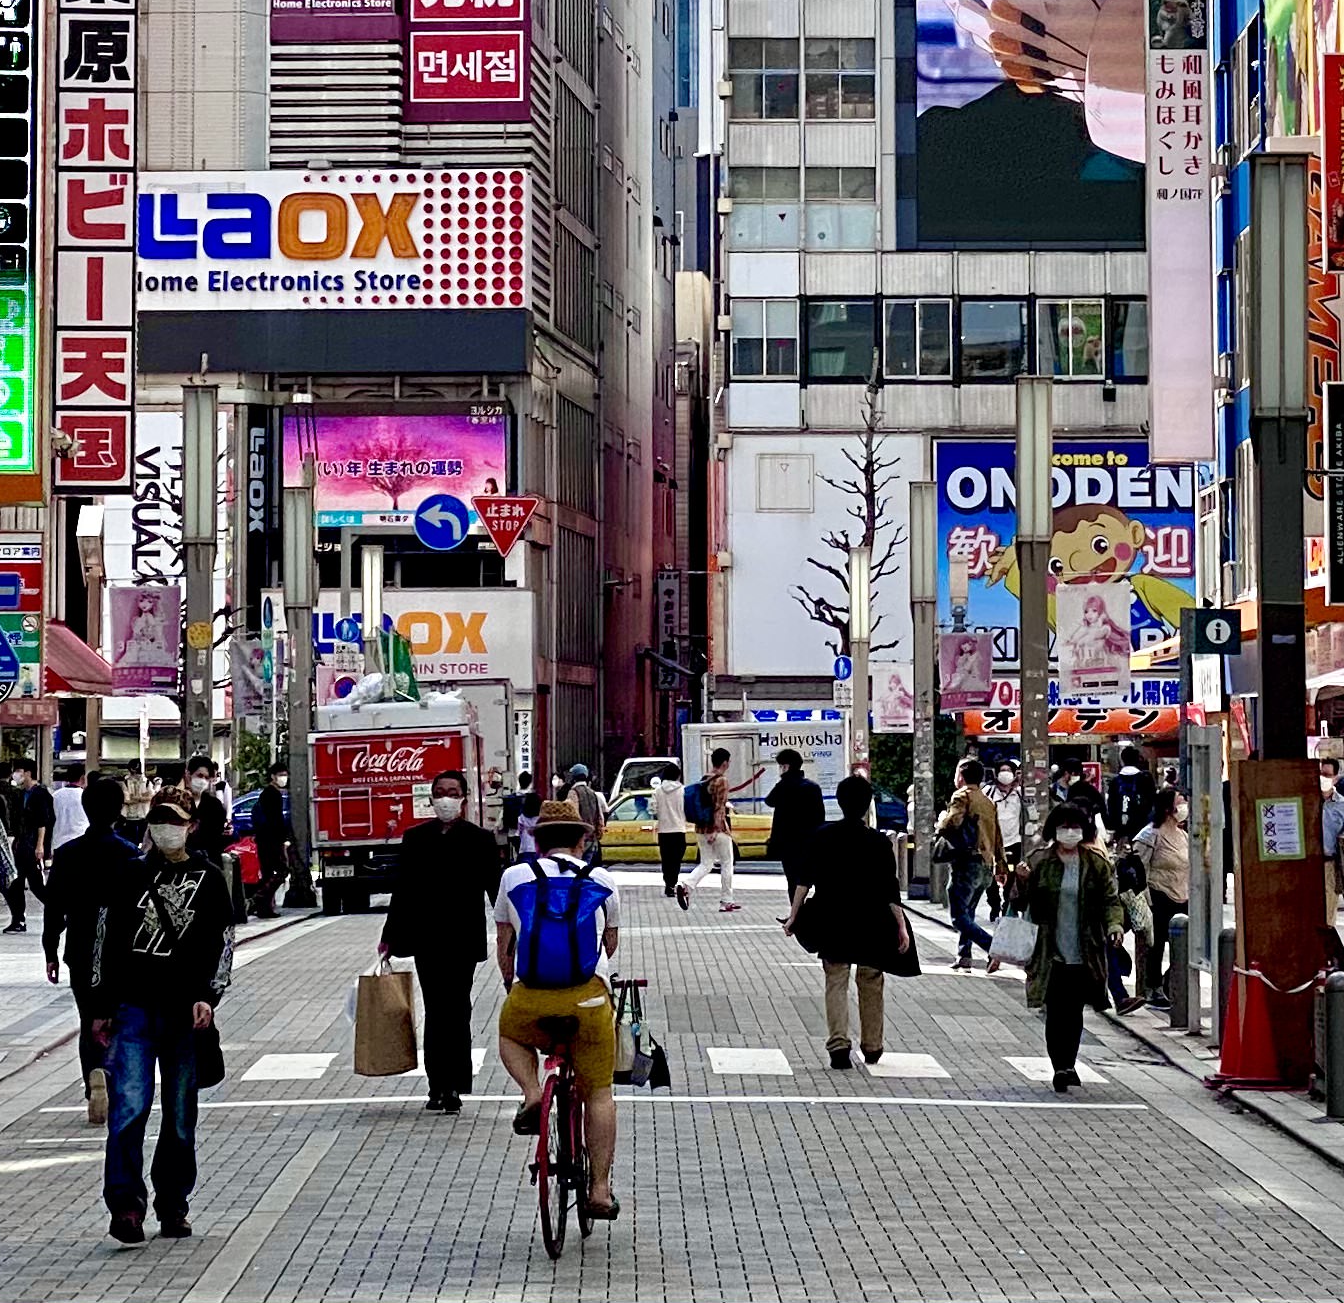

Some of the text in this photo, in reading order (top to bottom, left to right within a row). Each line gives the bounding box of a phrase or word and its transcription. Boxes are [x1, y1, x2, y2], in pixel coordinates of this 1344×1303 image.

[417, 48, 516, 84] 면세점
[1182, 54, 1203, 176] 和風耳かき
[207, 269, 345, 293] Electronics
[353, 269, 422, 292] Store
[1107, 450, 1129, 466] to
[131, 445, 161, 571] VISUAL
[485, 503, 526, 518] 止まれ
[490, 520, 520, 532] STOP
[439, 662, 489, 675] STORE
[758, 730, 843, 748] Hakuyosha
